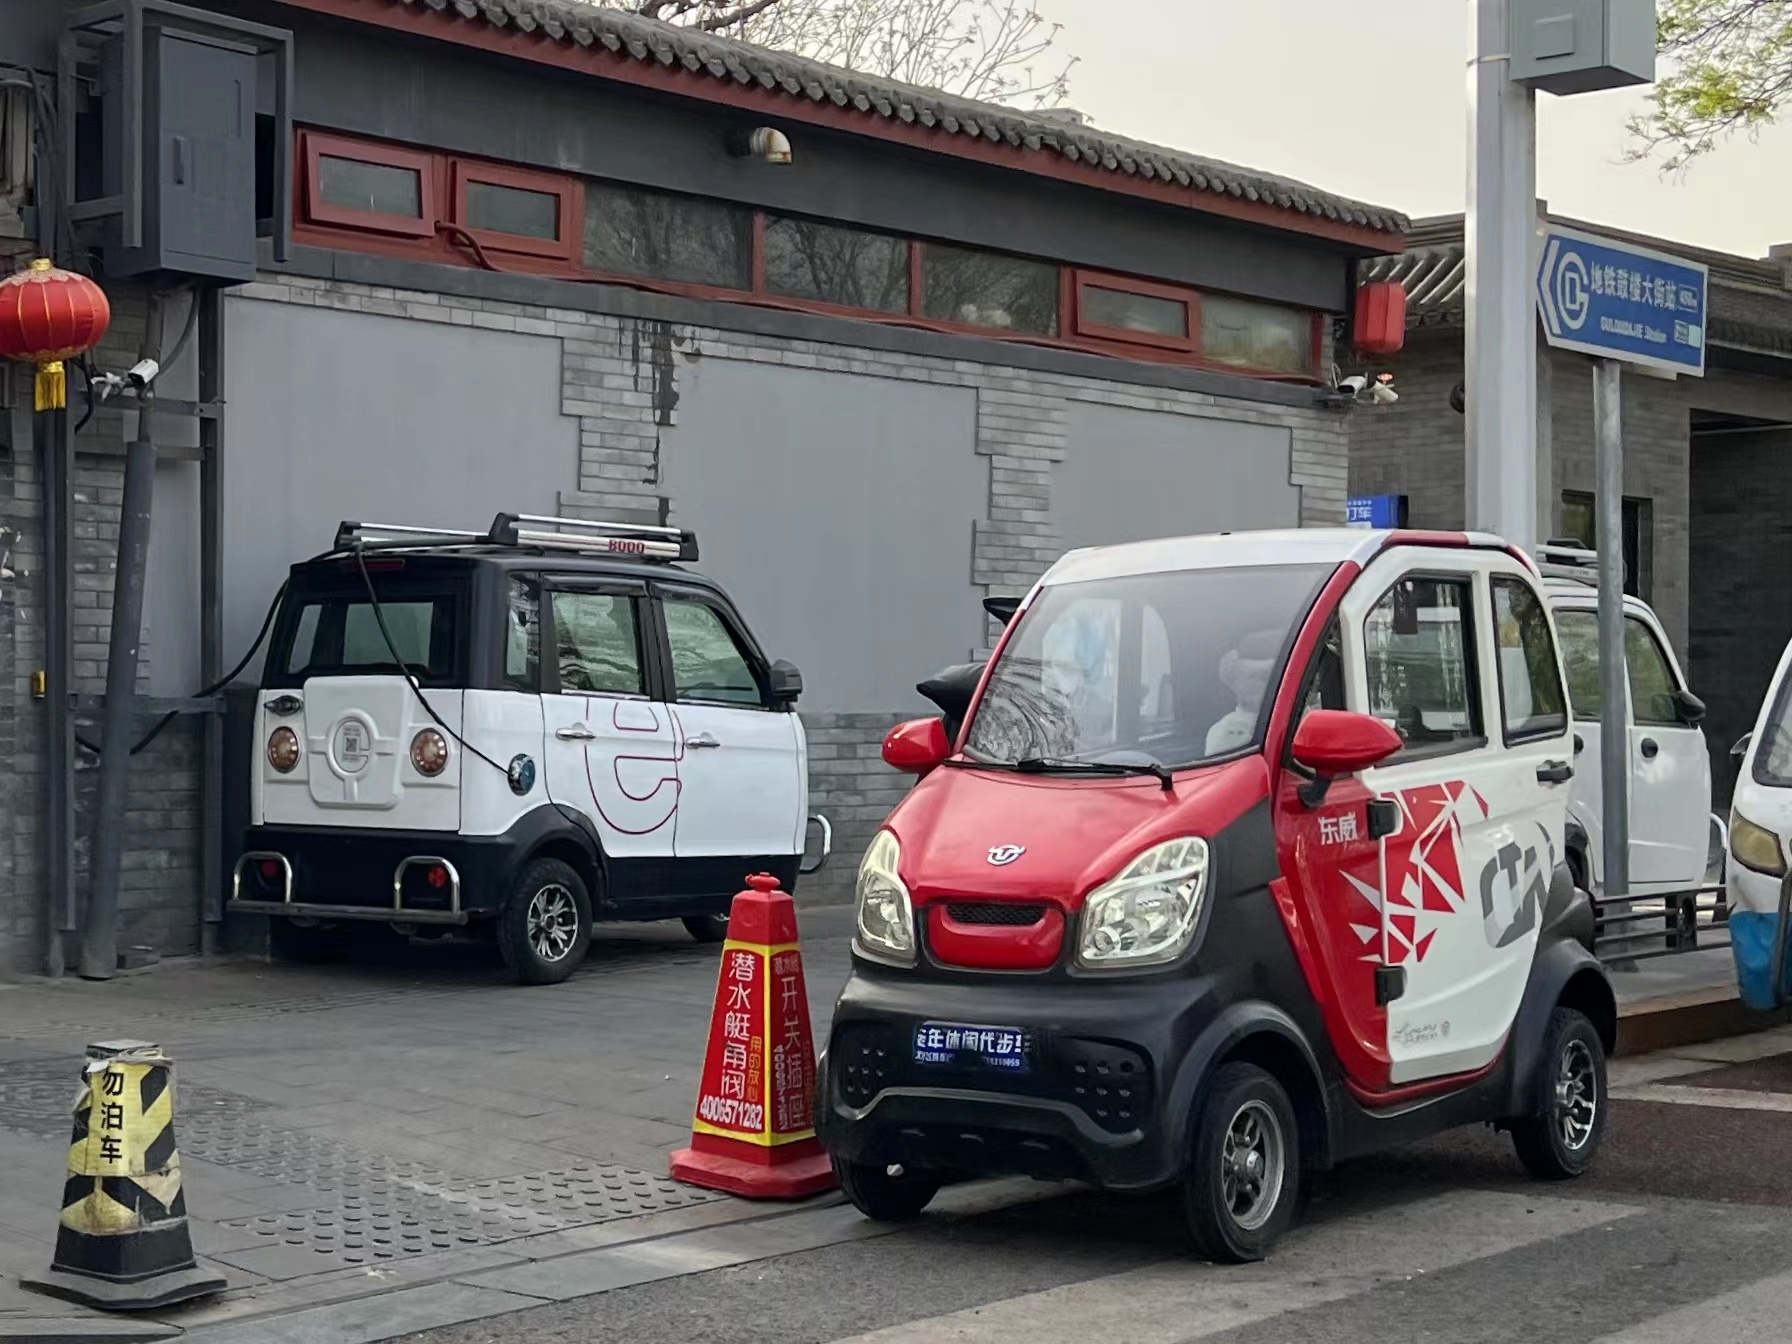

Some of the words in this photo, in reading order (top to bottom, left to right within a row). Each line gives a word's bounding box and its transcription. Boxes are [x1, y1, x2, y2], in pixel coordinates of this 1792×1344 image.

[1318, 812, 1358, 845] 东威
[721, 953, 755, 1099] 潜水艇角阀
[782, 976, 806, 1128] 开关插座
[100, 1069, 124, 1164] 勿泊车
[699, 1094, 763, 1131] 4006571282
